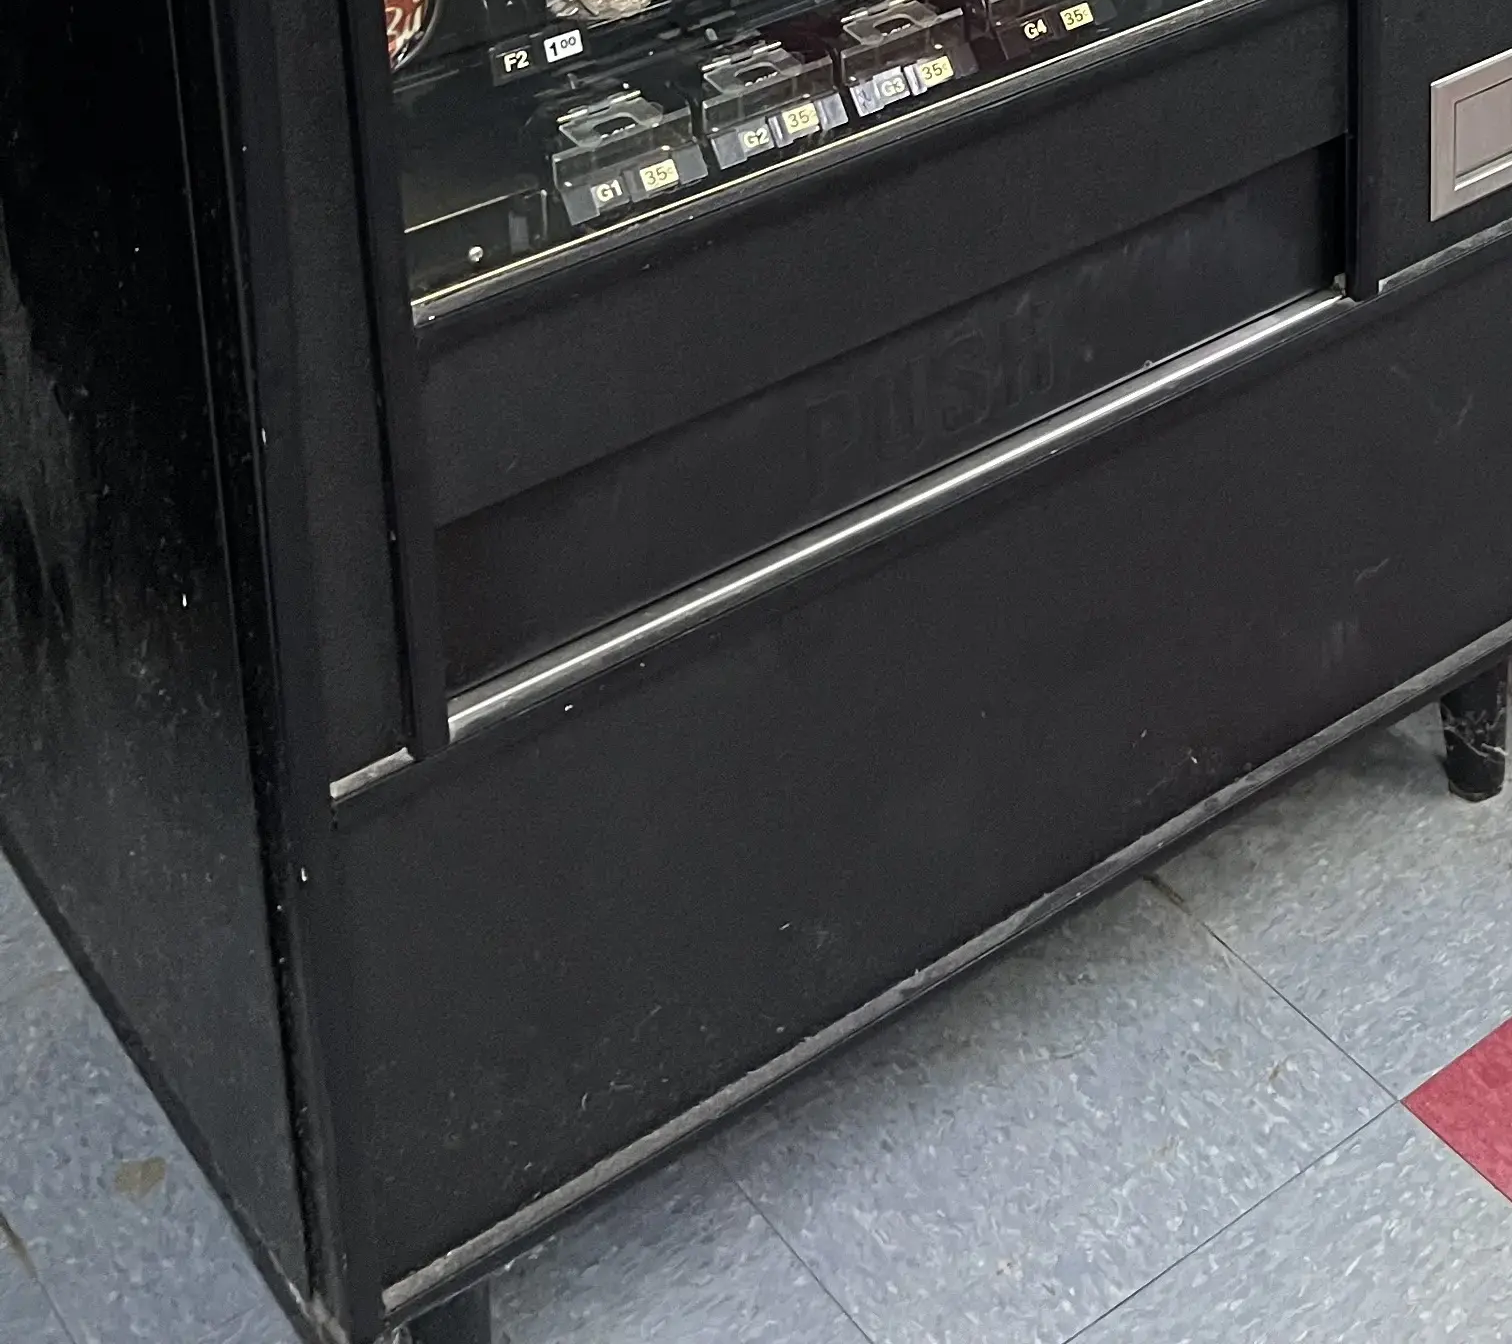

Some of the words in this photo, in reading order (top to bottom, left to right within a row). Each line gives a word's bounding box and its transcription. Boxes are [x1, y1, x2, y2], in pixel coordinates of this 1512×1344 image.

[1023, 20, 1048, 40] G4
[1063, 6, 1091, 28] 35¢
[503, 51, 530, 73] F2
[880, 77, 907, 98] G3
[921, 61, 949, 82] 35¢
[743, 126, 769, 148] G2
[788, 108, 819, 130] 35¢
[597, 180, 624, 203] G1
[643, 162, 675, 187] 35¢
